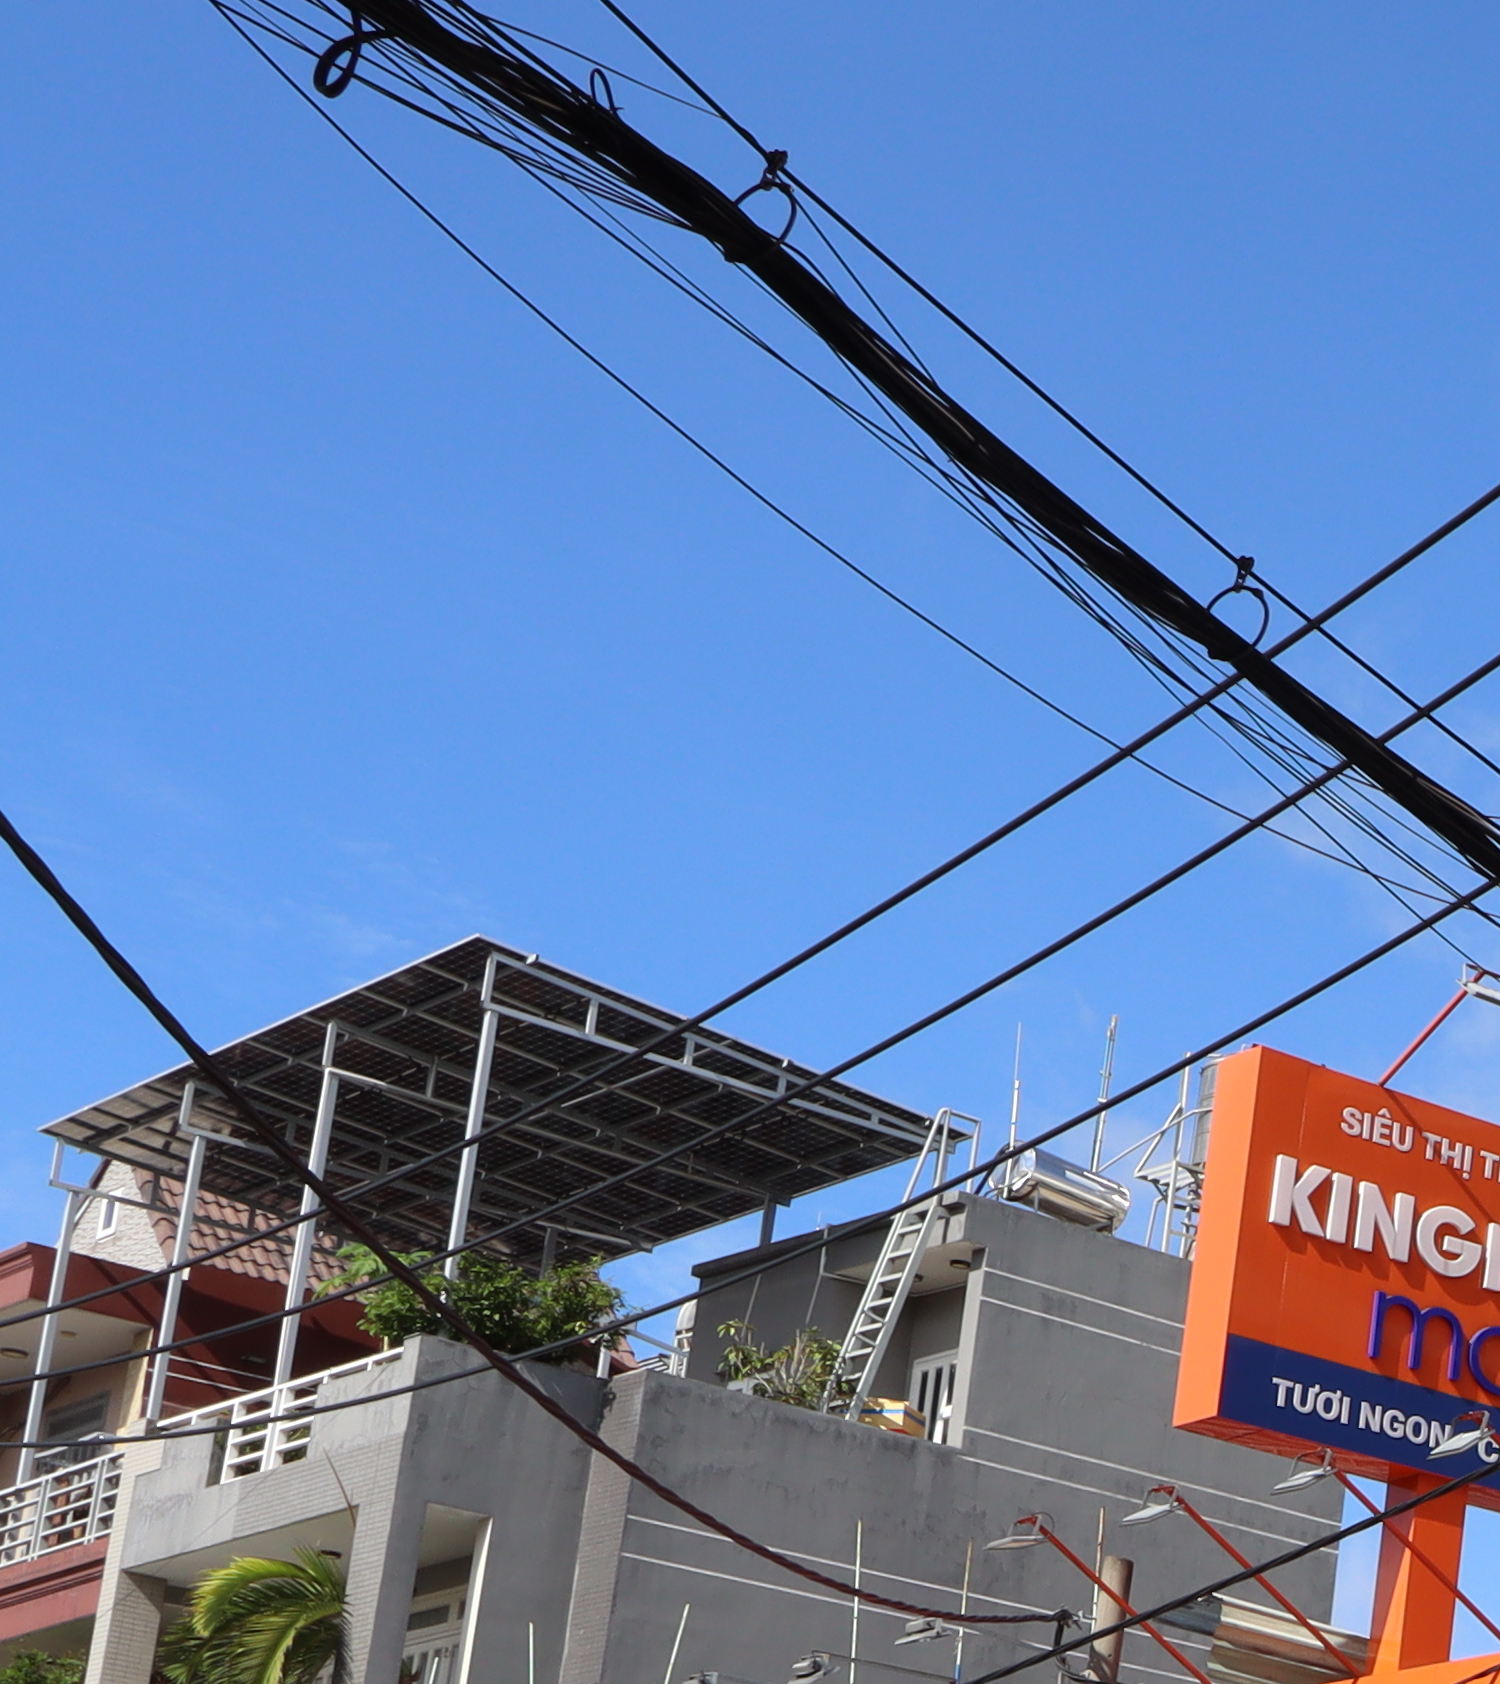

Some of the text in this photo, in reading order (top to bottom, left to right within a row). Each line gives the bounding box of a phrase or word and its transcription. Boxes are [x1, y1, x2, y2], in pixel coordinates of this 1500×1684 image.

[1340, 1107, 1415, 1154] SIÊU
[1421, 1131, 1474, 1181] THỊ
[1271, 1376, 1350, 1424] TƯƠI
